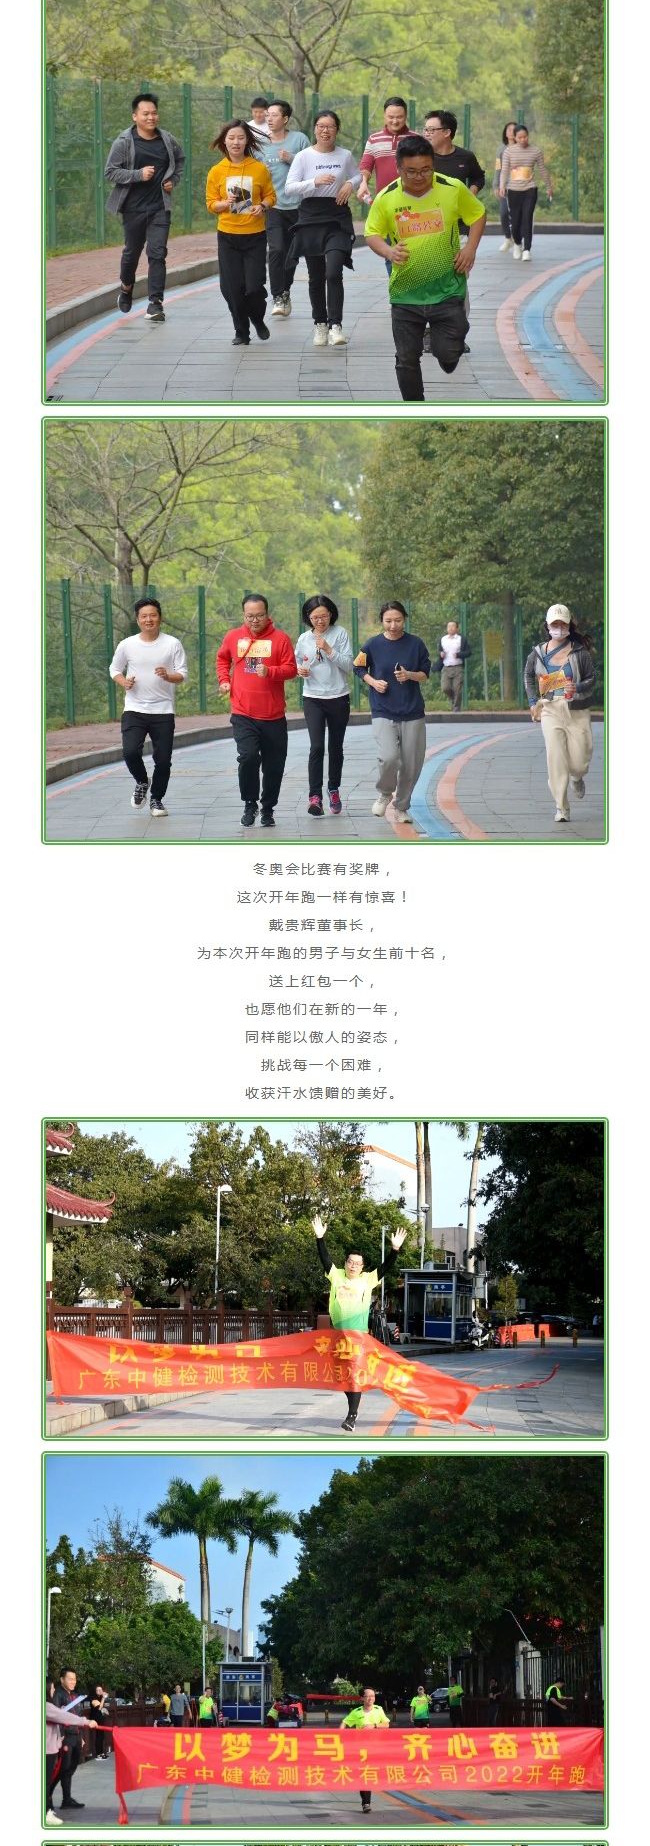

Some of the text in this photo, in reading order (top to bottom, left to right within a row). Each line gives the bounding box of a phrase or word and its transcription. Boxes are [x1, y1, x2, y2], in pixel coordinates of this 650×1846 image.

[174, 1731, 561, 1762] 以梦为马，齐心奋进
[137, 1762, 586, 1786] 广东中健检测技术有限公司2022开年跑
